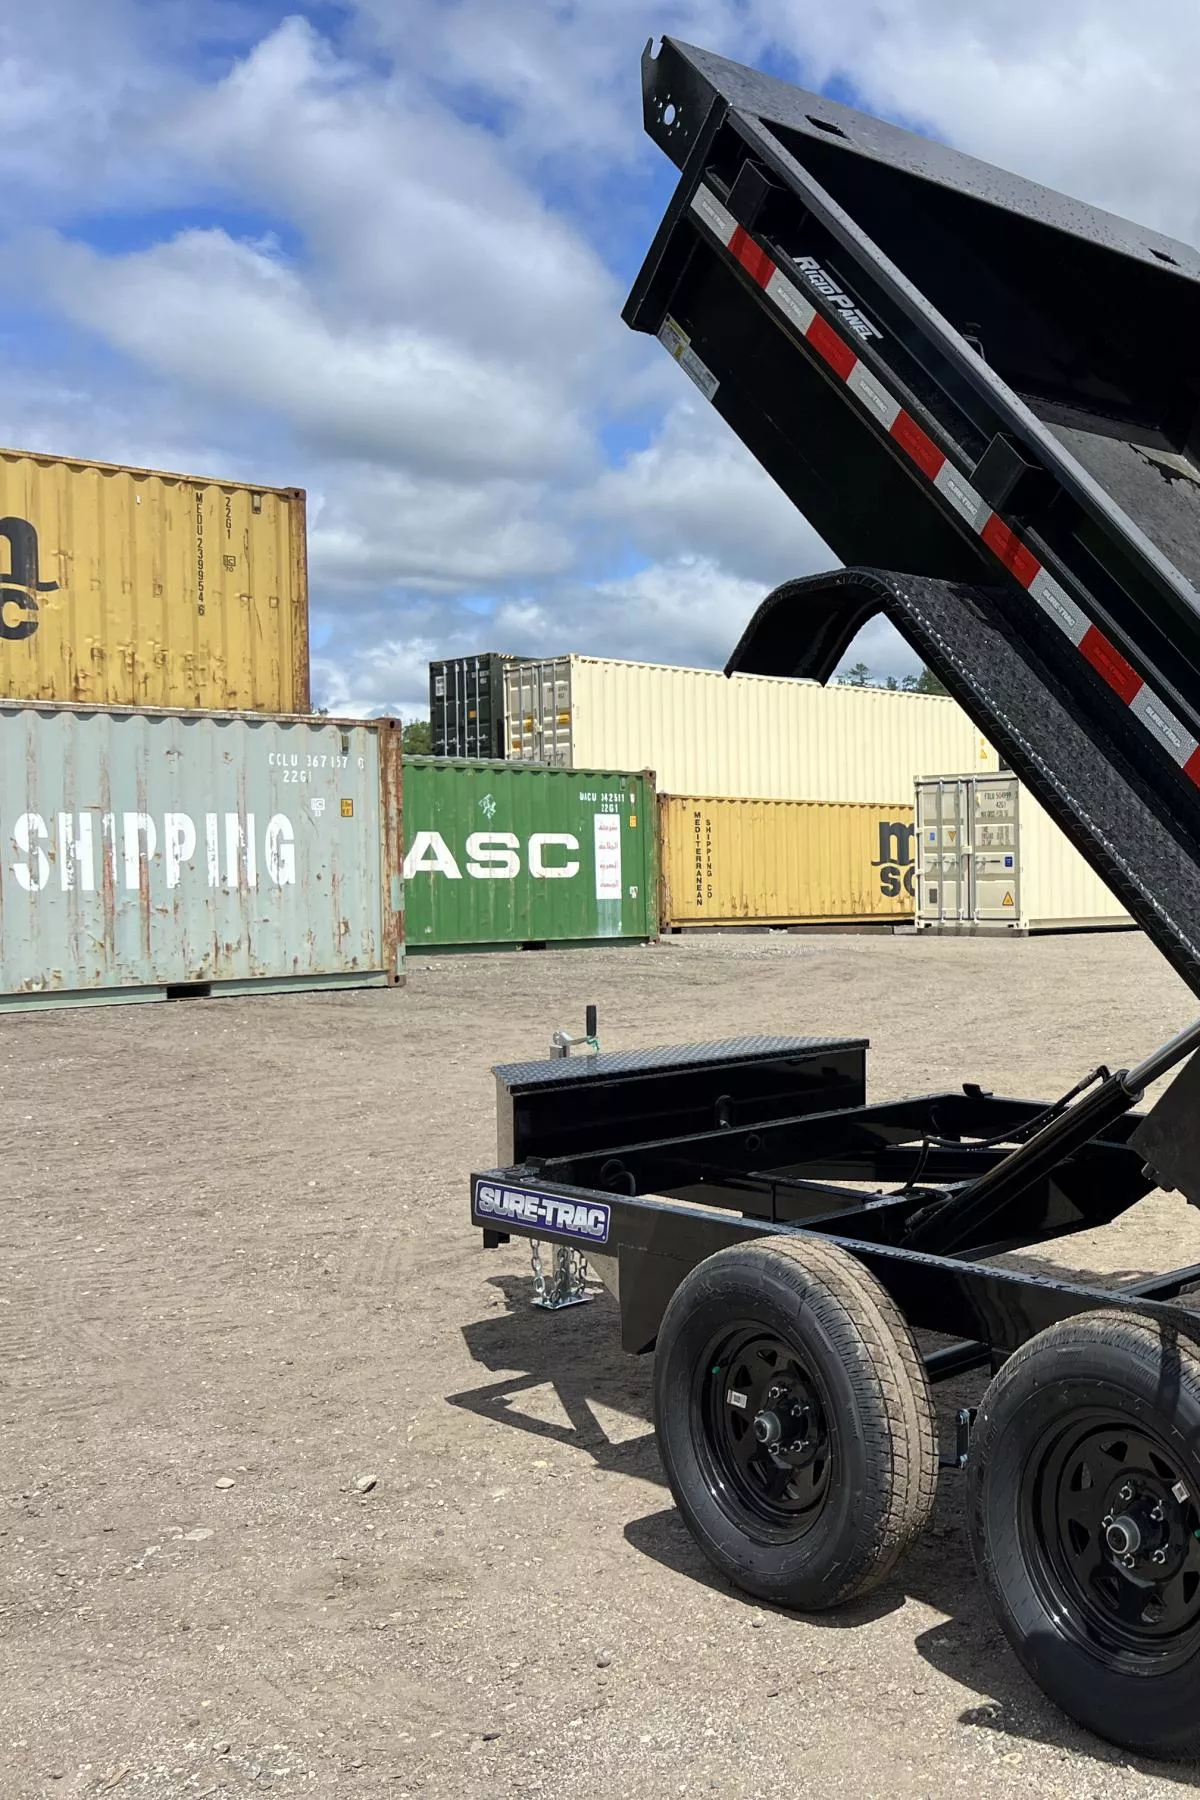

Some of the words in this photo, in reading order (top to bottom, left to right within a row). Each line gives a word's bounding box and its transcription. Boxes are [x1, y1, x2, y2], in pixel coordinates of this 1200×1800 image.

[792, 256, 837, 295] RIGID
[827, 294, 875, 340] PANEL
[1042, 587, 1076, 628] SURE-TRAC
[1145, 705, 1182, 748] SURE-TRAC
[268, 753, 298, 767] CCLU
[283, 770, 312, 783] 22G1
[13, 812, 296, 892] SHIPPING
[694, 811, 703, 906] MEDITERRANEAN
[705, 819, 713, 877] SHIPPING
[707, 884, 713, 898] CO
[479, 1186, 606, 1236] SURE-TRAC
